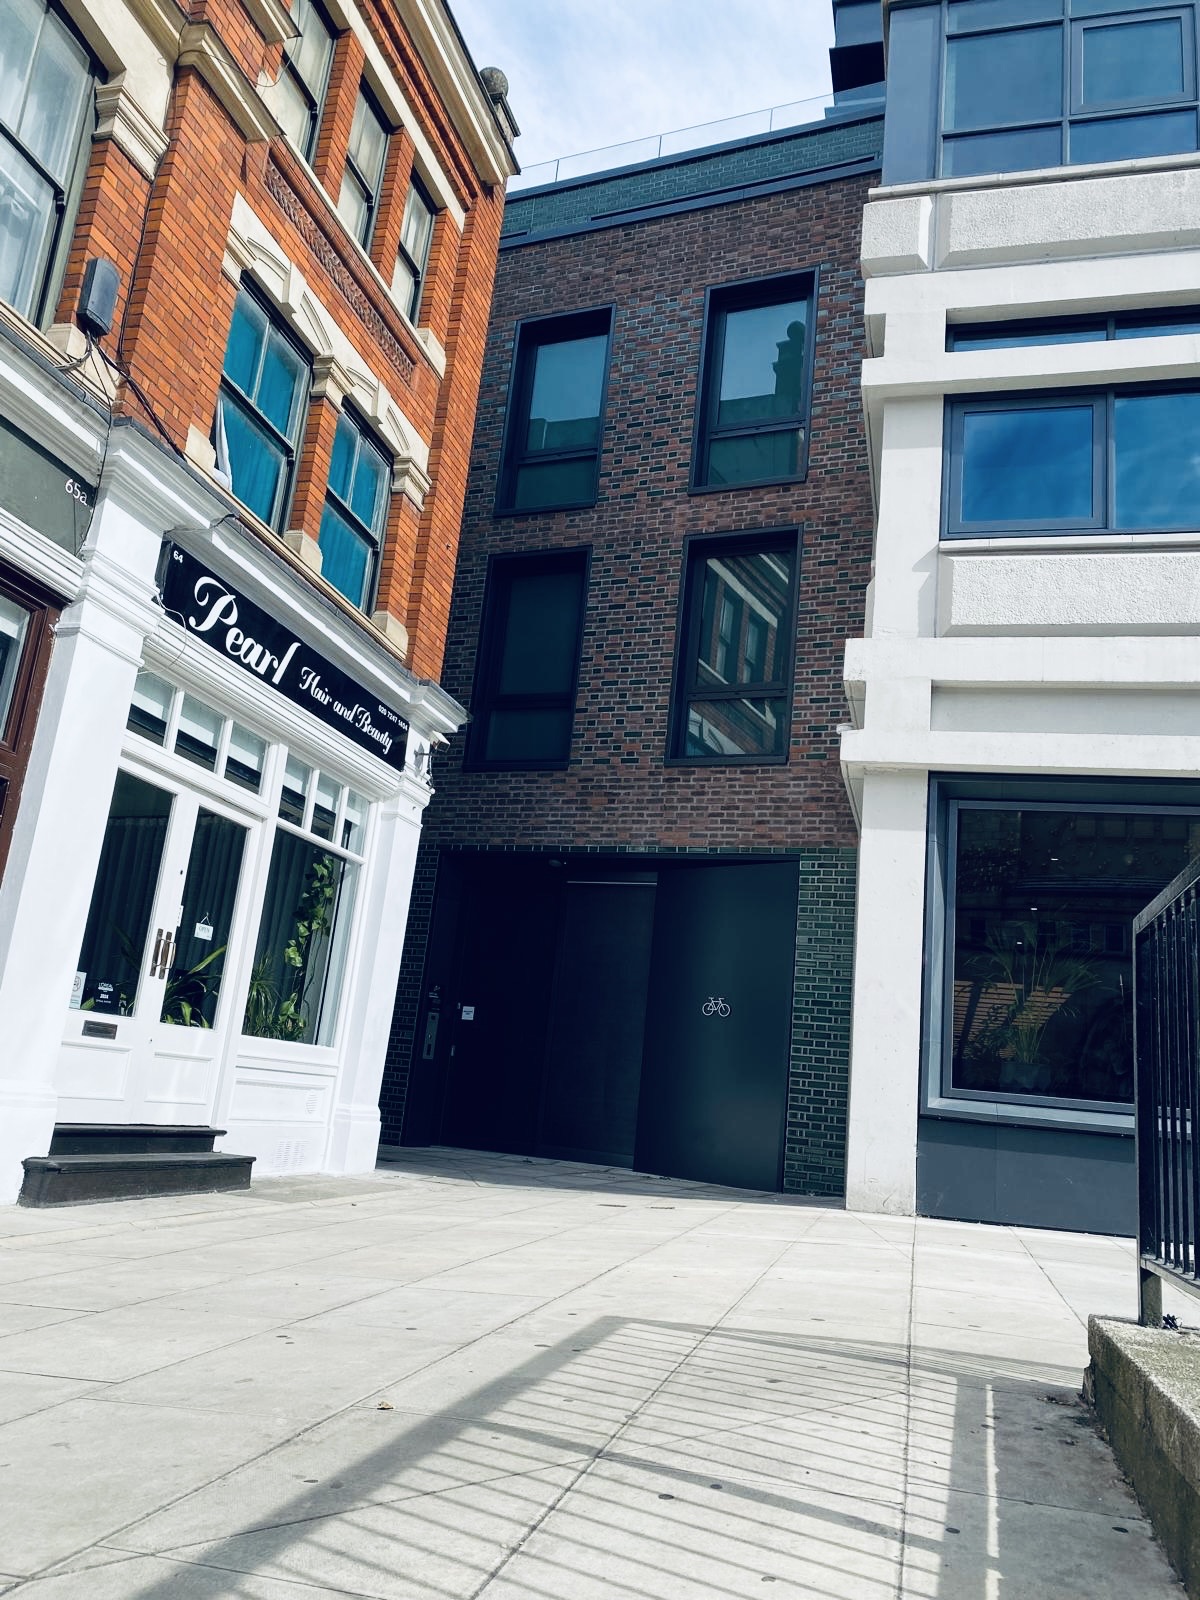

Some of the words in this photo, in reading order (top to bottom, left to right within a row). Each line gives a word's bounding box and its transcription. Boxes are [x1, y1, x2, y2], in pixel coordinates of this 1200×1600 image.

[65, 479, 88, 506] 65a
[173, 550, 184, 563] 64
[188, 575, 302, 685] Pearl
[299, 666, 333, 706] Hair
[333, 701, 360, 723] and
[355, 707, 393, 755] Beauty
[378, 704, 387, 716] 020
[387, 710, 398, 723] 7247
